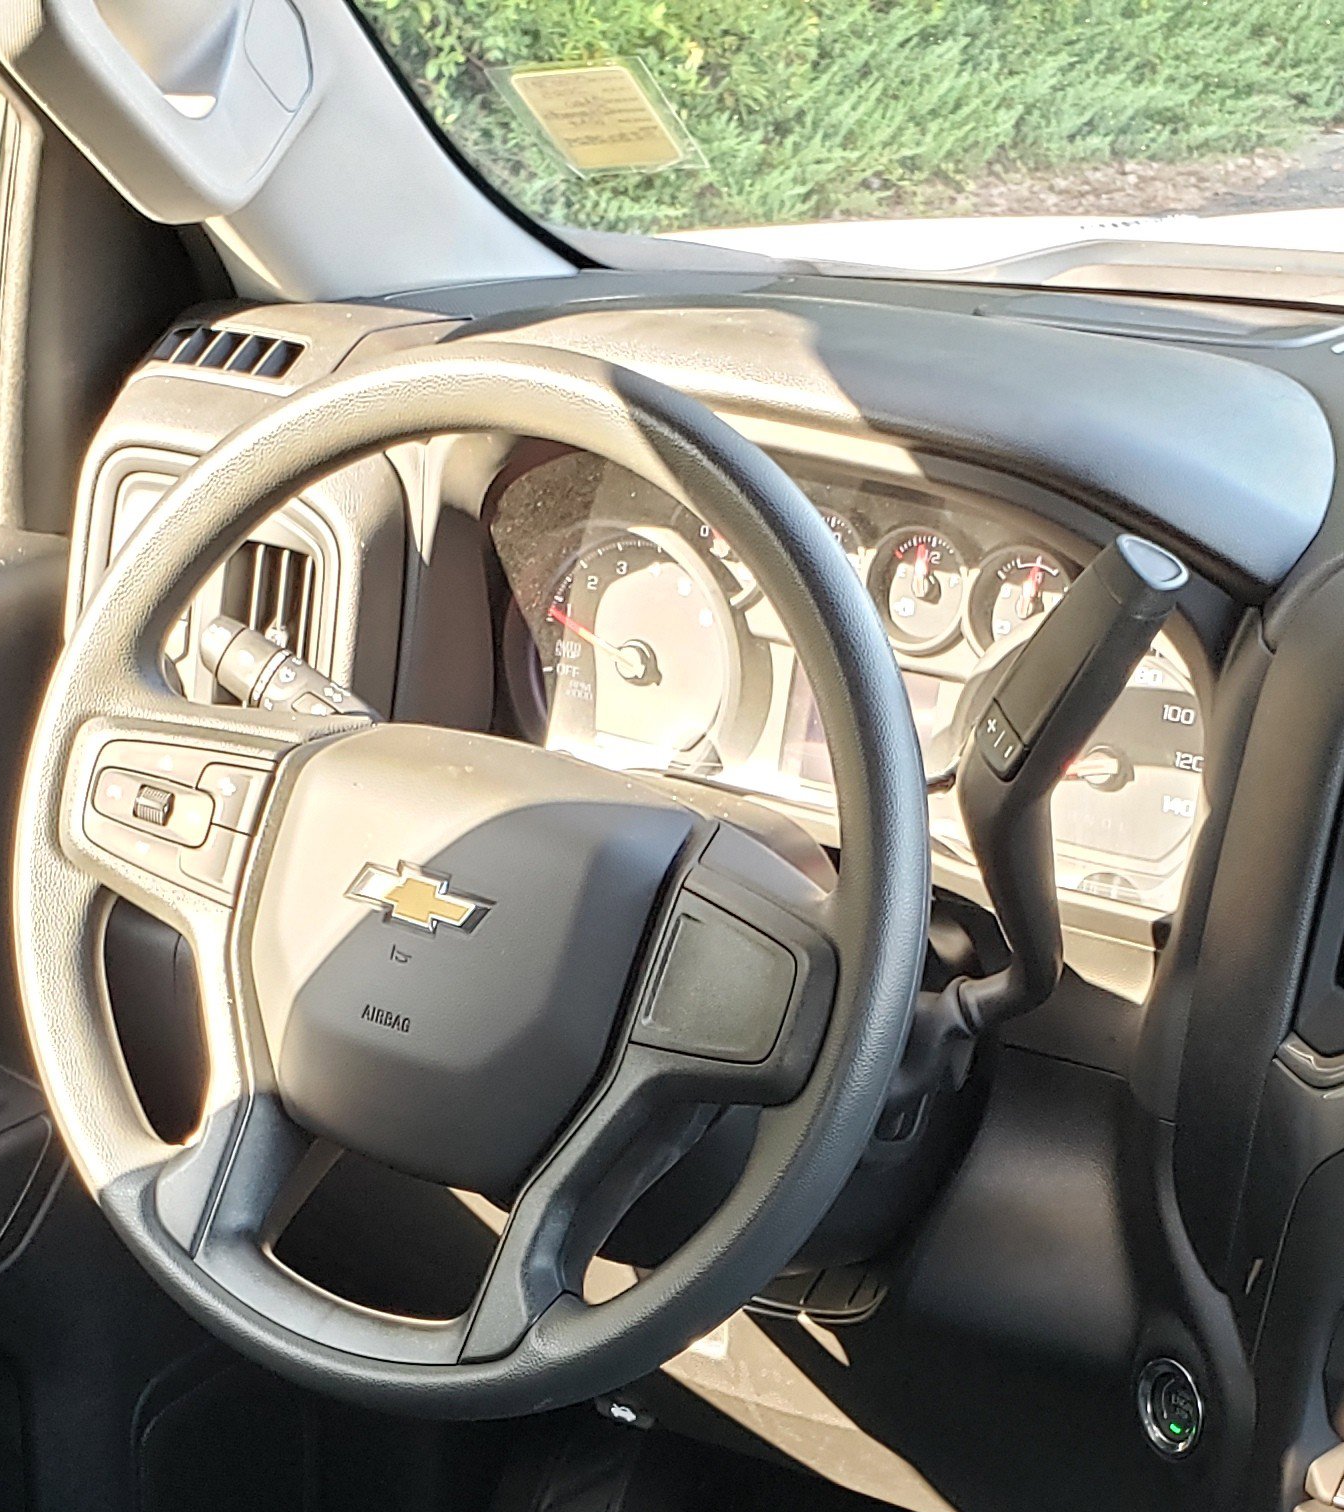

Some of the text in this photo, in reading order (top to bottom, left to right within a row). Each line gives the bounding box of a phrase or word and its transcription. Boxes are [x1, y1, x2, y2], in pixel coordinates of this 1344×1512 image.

[615, 560, 628, 576] 3
[587, 575, 599, 590] 2
[556, 663, 580, 677] OFF
[1162, 703, 1195, 726] 100
[1162, 794, 1196, 818] 140
[361, 1003, 411, 1033] AIRBAG
